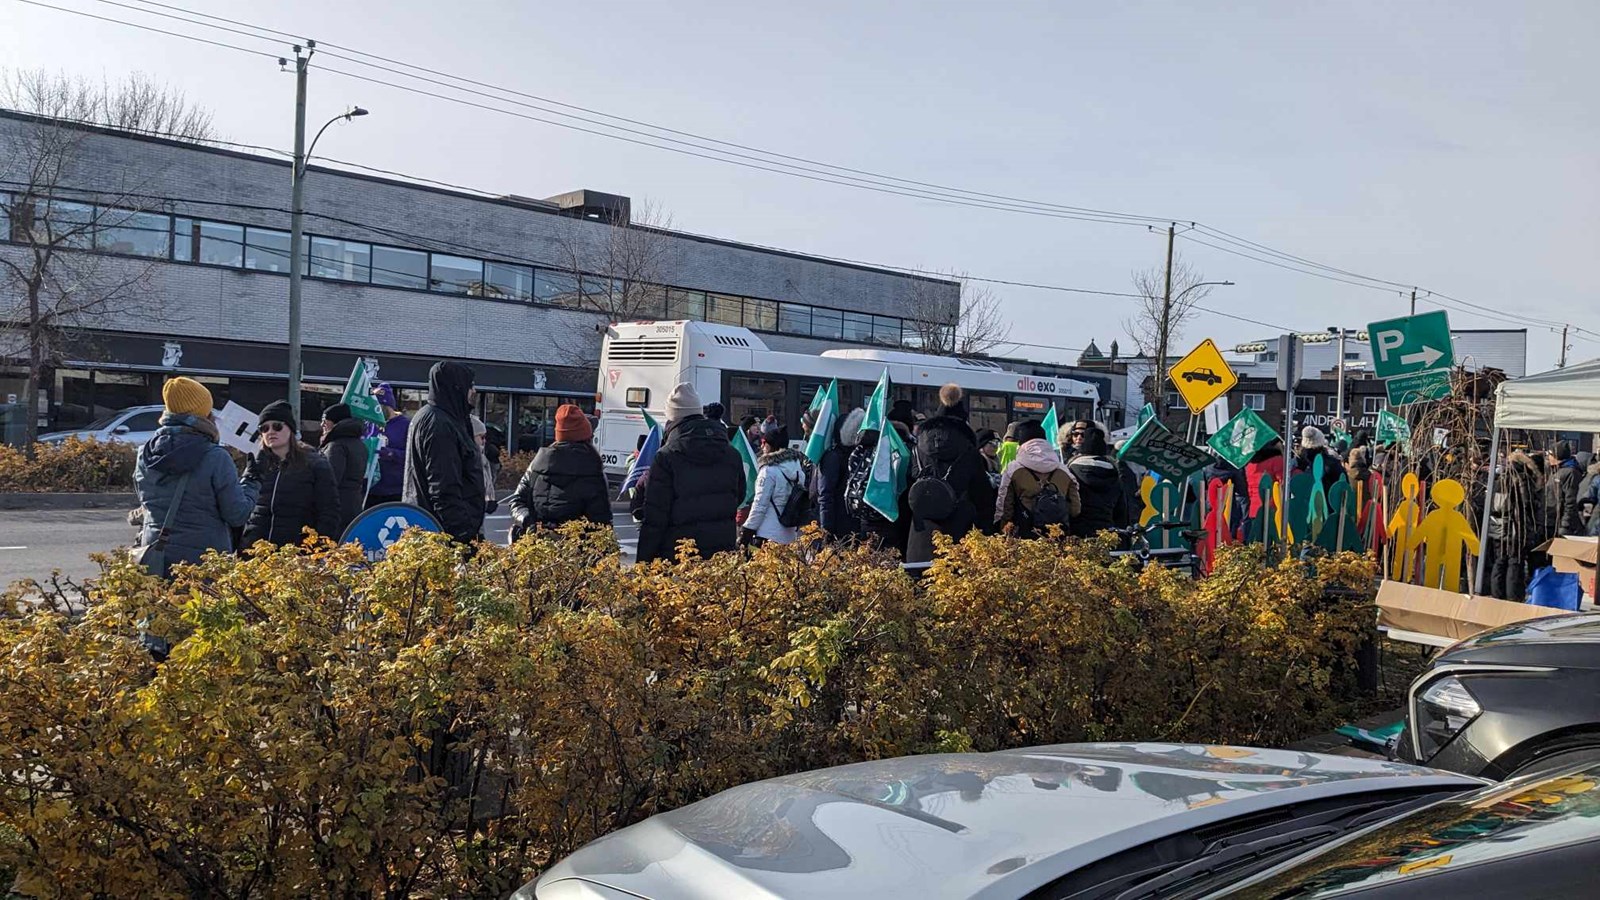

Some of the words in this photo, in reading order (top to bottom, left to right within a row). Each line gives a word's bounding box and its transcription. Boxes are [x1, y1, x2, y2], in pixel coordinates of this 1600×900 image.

[1377, 329, 1405, 362] P
[1017, 376, 1036, 392] allo
[1037, 381, 1056, 393] exo
[601, 454, 618, 465] exo
